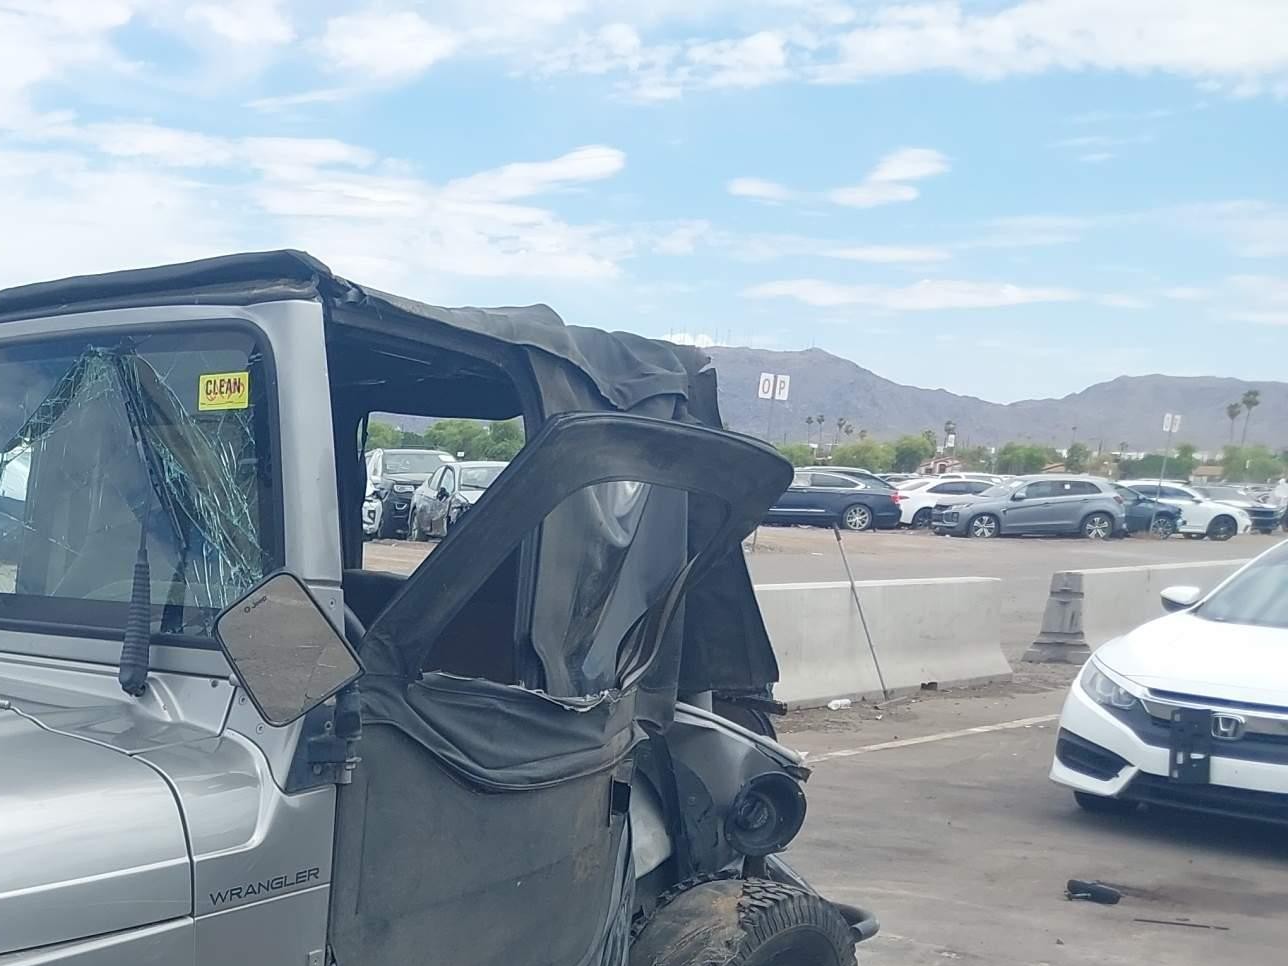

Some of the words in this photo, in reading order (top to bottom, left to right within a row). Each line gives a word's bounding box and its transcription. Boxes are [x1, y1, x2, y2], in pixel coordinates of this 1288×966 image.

[205, 378, 241, 396] CLEAN
[778, 380, 786, 395] P
[209, 867, 320, 906] WRANGLER
